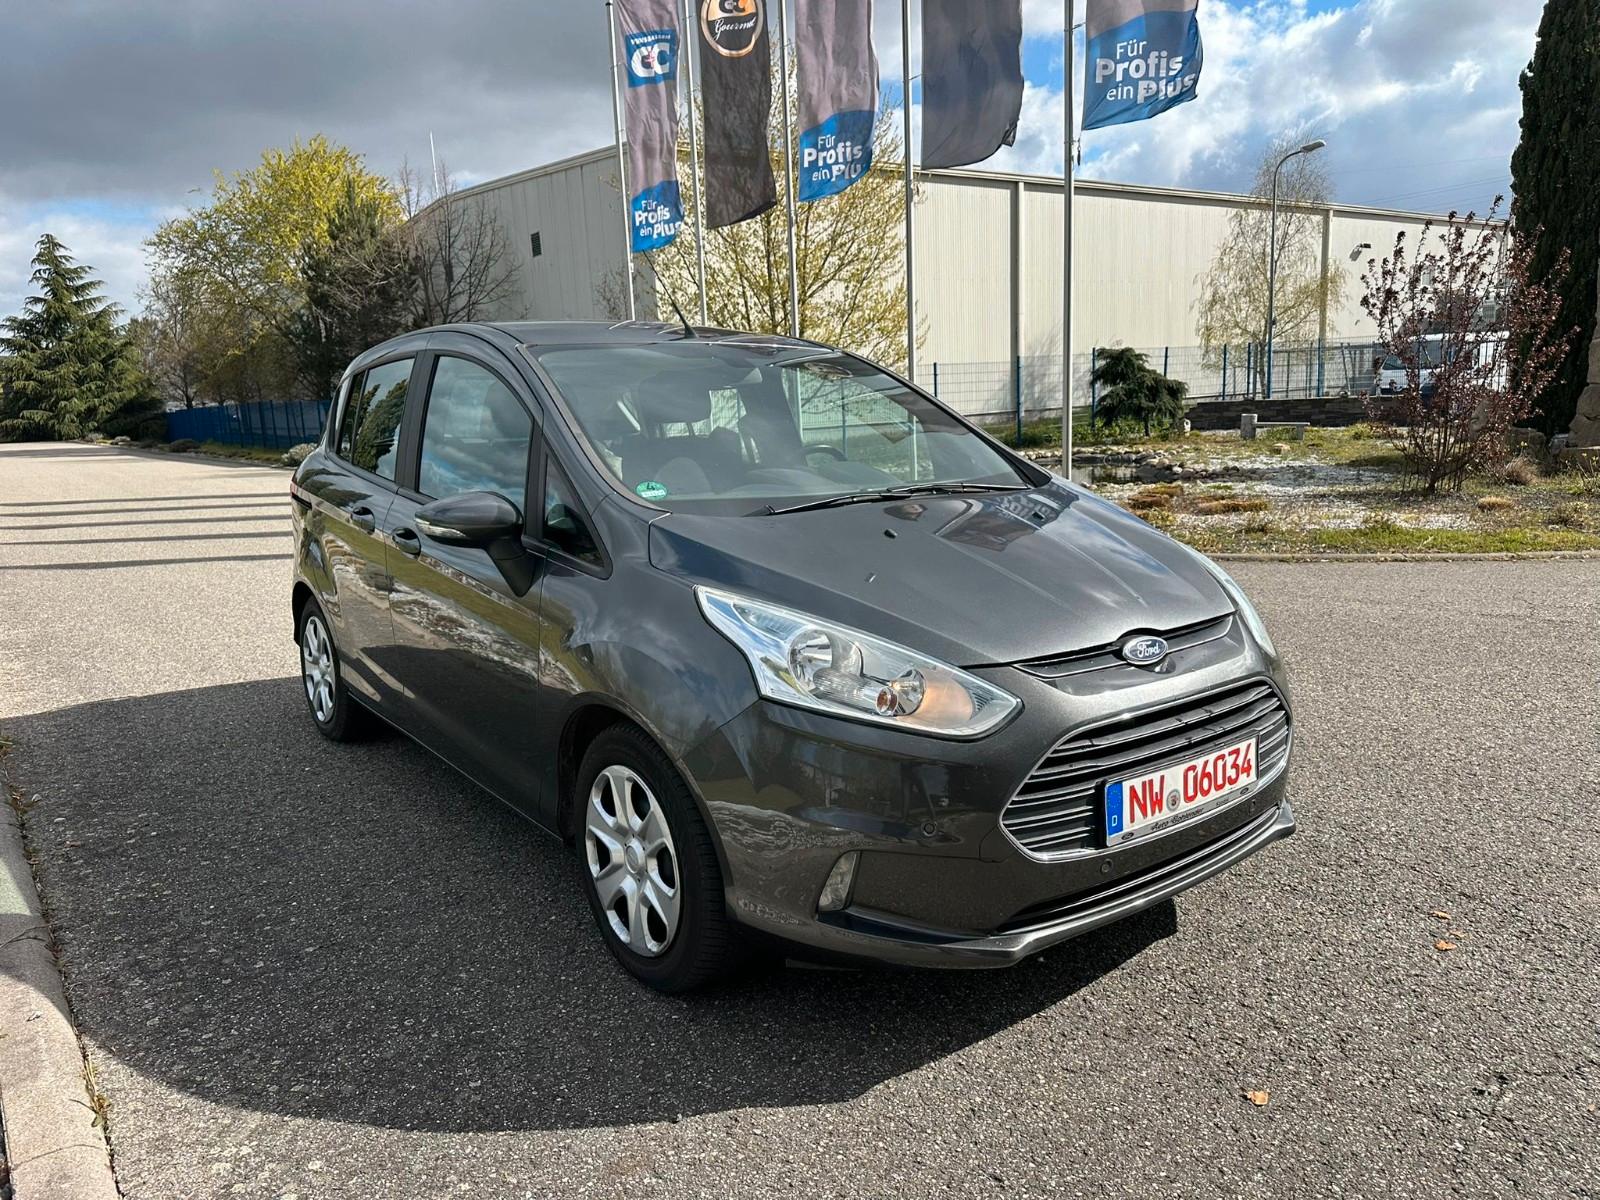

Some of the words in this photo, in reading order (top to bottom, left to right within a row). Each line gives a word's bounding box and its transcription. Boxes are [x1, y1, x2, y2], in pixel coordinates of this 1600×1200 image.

[1116, 39, 1147, 60] Für
[1095, 50, 1183, 84] Profis
[1106, 83, 1134, 101] ein
[1137, 73, 1196, 104] Plus
[818, 134, 836, 149] Für
[803, 141, 863, 168] Profis
[812, 168, 830, 181] ein
[831, 163, 866, 182] Plu
[640, 225, 652, 237] ein
[1136, 640, 1160, 658] Ford
[1129, 774, 1165, 824] NW
[1183, 742, 1252, 804] 06034
